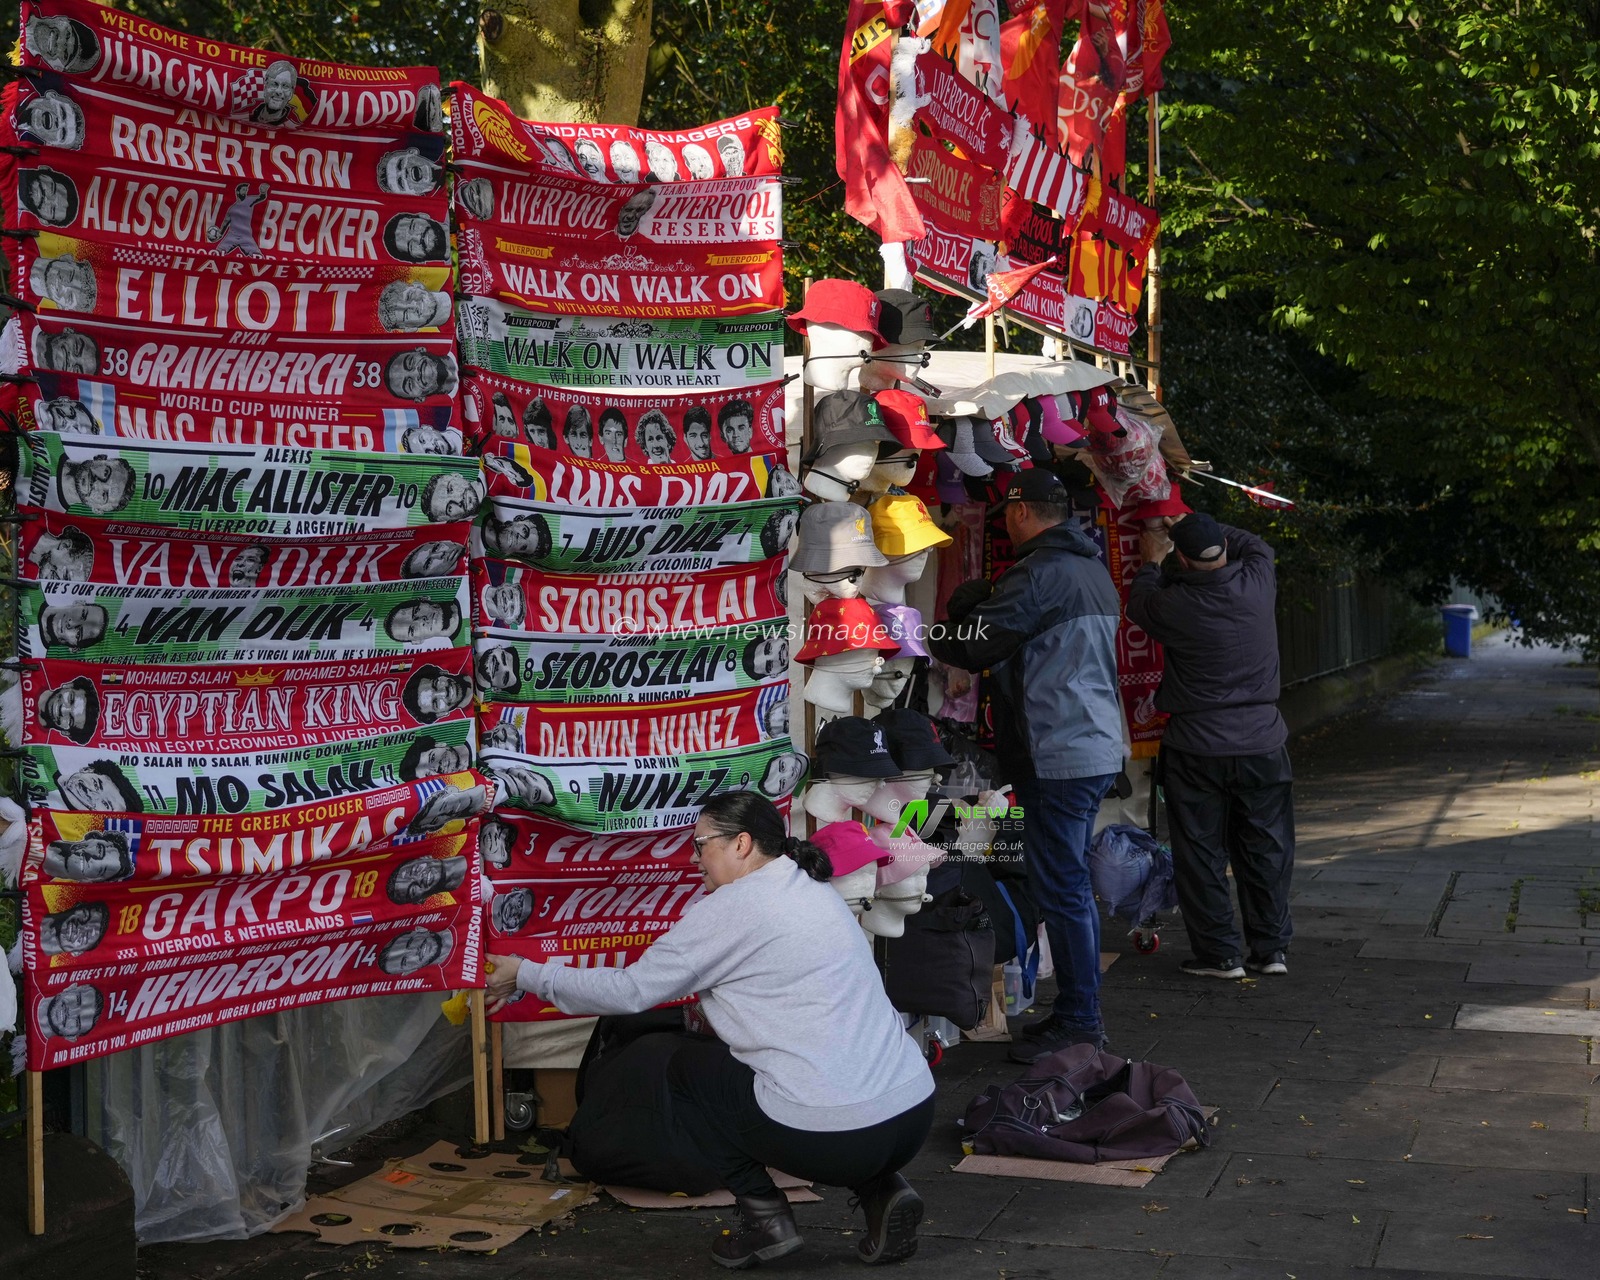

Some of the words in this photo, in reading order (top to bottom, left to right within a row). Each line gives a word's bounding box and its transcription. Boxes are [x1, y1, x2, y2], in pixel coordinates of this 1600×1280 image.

[100, 10, 189, 50] WELCOME
[199, 41, 220, 57] TO
[229, 47, 267, 67] THE
[299, 62, 333, 79] KLOPP
[337, 65, 408, 80] REVOLUTION
[93, 32, 229, 110] JÜRGEN
[313, 88, 416, 127] KLOPP
[933, 69, 980, 126] LIVERPOOL
[976, 105, 991, 138] FC
[464, 102, 476, 130] WALK
[473, 131, 484, 147] ON
[629, 117, 752, 144] MANAGERS
[111, 115, 353, 189] ROBERTSON
[500, 181, 618, 230] LIVERPOOL
[654, 191, 775, 219] LIVERPOOL
[659, 183, 689, 196] TEAMS
[82, 175, 223, 243] ALISSON
[259, 199, 379, 259] BECKER
[651, 221, 775, 236] RESERVES
[171, 256, 314, 278] HARVEY
[505, 244, 545, 257] LIVERPOOL
[716, 254, 763, 264] LIVERPOOL
[934, 237, 970, 272] DIAZ
[500, 262, 575, 300] WALK
[580, 274, 619, 302] ON
[629, 276, 710, 303] WALK
[717, 273, 763, 300] ON
[117, 268, 360, 332] ELLIOTT
[1041, 297, 1065, 320] KING
[229, 331, 271, 345] RYAN
[511, 318, 552, 329] LIVERPOOL
[724, 323, 775, 333] LIVERPOOL
[102, 349, 128, 376] 38
[129, 342, 356, 395] GRAVENBERCH
[353, 362, 381, 388] 38
[504, 337, 577, 368] WALK
[583, 344, 621, 369] ON
[635, 344, 717, 370] WALK
[726, 342, 772, 368] ON
[583, 373, 617, 385] HOPE
[635, 374, 674, 385] YOUR
[677, 374, 721, 385] HEART
[161, 393, 222, 412] WORLD
[229, 401, 264, 417] CUP
[270, 405, 339, 421] WINNER
[538, 388, 602, 406] LIVERPOOL'S
[605, 398, 674, 408] MAGNIFICENT
[264, 448, 312, 464] ALEXIS
[562, 456, 632, 474] LIVERPOOL
[653, 462, 720, 474] COLOMBIA
[142, 473, 165, 501] 10
[160, 466, 251, 513] MAC
[245, 469, 394, 517] ALLISTER
[396, 484, 418, 509] 10
[1008, 487, 1021, 496] AP1
[189, 518, 275, 535] LIVERPOOL
[573, 525, 656, 564] LUIS
[109, 540, 238, 588] VAN
[269, 544, 400, 587] DIJK
[649, 557, 713, 571] COLOMBIA
[45, 582, 69, 594] HE'S
[72, 584, 92, 596] OUR
[95, 584, 133, 598] CENTRE
[135, 589, 161, 599] HALF
[211, 590, 248, 600] NUMBER
[539, 576, 757, 634] SZOBOSZLAI
[135, 607, 247, 645] VAN
[238, 602, 367, 641] DIJK
[234, 650, 253, 660] HE'S
[257, 650, 288, 660] VIRGIL
[292, 650, 310, 660] VAN
[523, 658, 534, 682] 8
[535, 644, 726, 691] SZOBOSZLAI
[125, 671, 187, 685] MOHAMED
[189, 671, 231, 685] SALAH
[283, 667, 345, 681] MOHAMED
[348, 662, 389, 676] SALAH
[101, 684, 297, 738] EGYPTIAN
[303, 679, 400, 729] KING
[540, 719, 639, 757] DARWIN
[650, 706, 741, 756] NUNEZ
[120, 755, 138, 766] MO
[144, 756, 182, 767] SALAH
[187, 757, 206, 767] MO
[255, 751, 310, 766] RUNNING
[315, 743, 350, 758] DOWN
[383, 732, 415, 746] WING
[634, 756, 679, 769] DARWIN
[176, 775, 250, 815] MO
[258, 759, 379, 809] SALAH
[569, 780, 581, 803] 9
[203, 818, 233, 833] THE
[241, 813, 291, 832] GREEK
[298, 799, 363, 823] SCOUSER
[612, 871, 683, 884] IBRAHIMA
[117, 904, 142, 935] 18
[142, 869, 352, 940] GAKPO
[352, 871, 378, 898] 18
[144, 931, 220, 956] LIVERPOOL
[239, 914, 344, 941] NETHERLANDS
[462, 905, 482, 982] HENDERSON
[561, 922, 625, 937] LIVERPOOL
[563, 934, 652, 951] LIVERPOOL
[109, 990, 128, 1019] 14
[125, 940, 362, 1023] HENDERSON
[353, 945, 377, 968] 14
[53, 1051, 67, 1064] AND
[70, 1042, 95, 1059] HERE'S
[130, 1026, 162, 1043] JORDAN
[216, 1004, 249, 1021] JURGEN
[252, 999, 276, 1013] LOVES
[300, 991, 321, 1002] MORE
[325, 987, 348, 999] THAN
[351, 984, 368, 994] YOU
[370, 982, 391, 992] WILL
